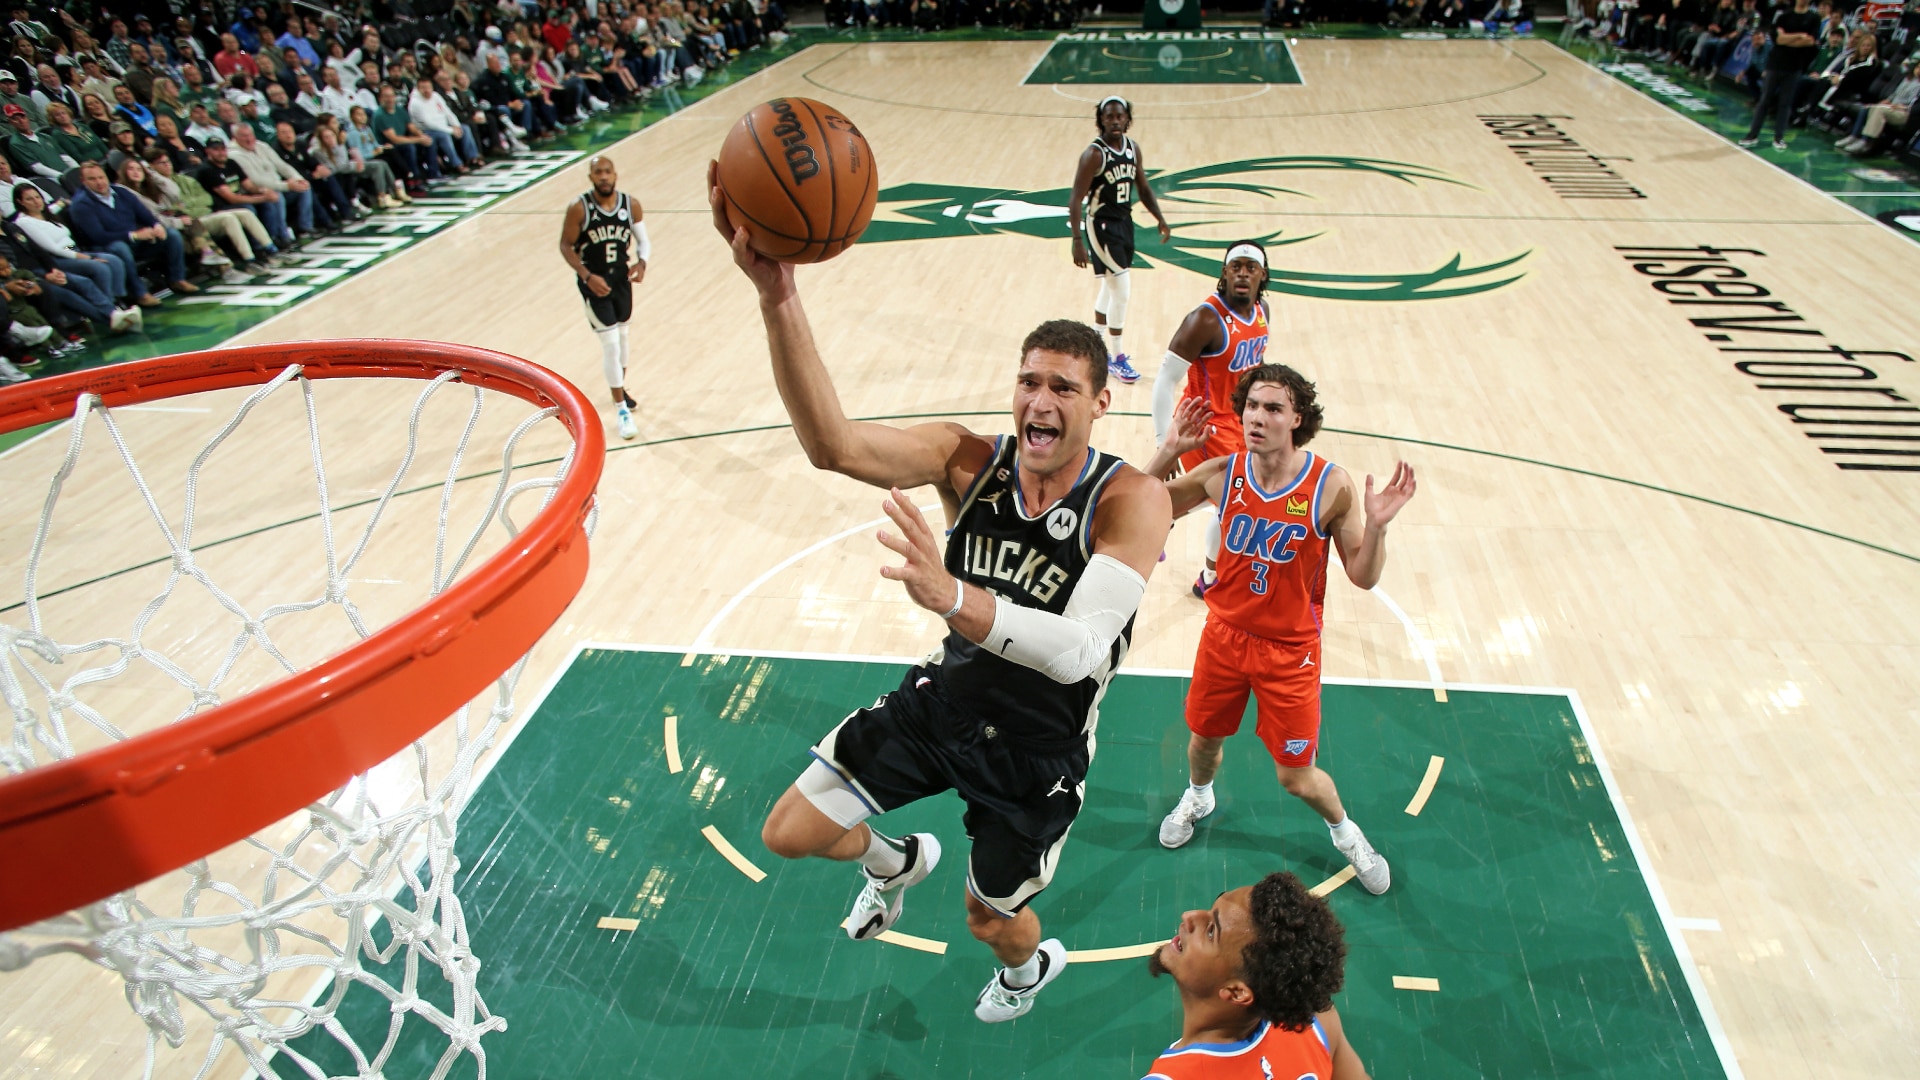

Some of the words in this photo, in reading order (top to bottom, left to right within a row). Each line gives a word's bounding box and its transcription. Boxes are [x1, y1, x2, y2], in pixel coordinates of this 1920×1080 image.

[1055, 31, 1286, 41] MILWAUKEE
[1475, 114, 1648, 199] fiserv.forum
[1104, 163, 1137, 184] BUCKS
[1116, 181, 1131, 204] 21
[342, 193, 500, 234] THE
[587, 224, 631, 244] BUCKS
[605, 242, 618, 264] 5
[996, 467, 1011, 482] 6
[1233, 477, 1244, 489] 6
[1225, 513, 1308, 563] OKC
[964, 532, 1069, 604] UCKS
[1249, 560, 1269, 595] 3
